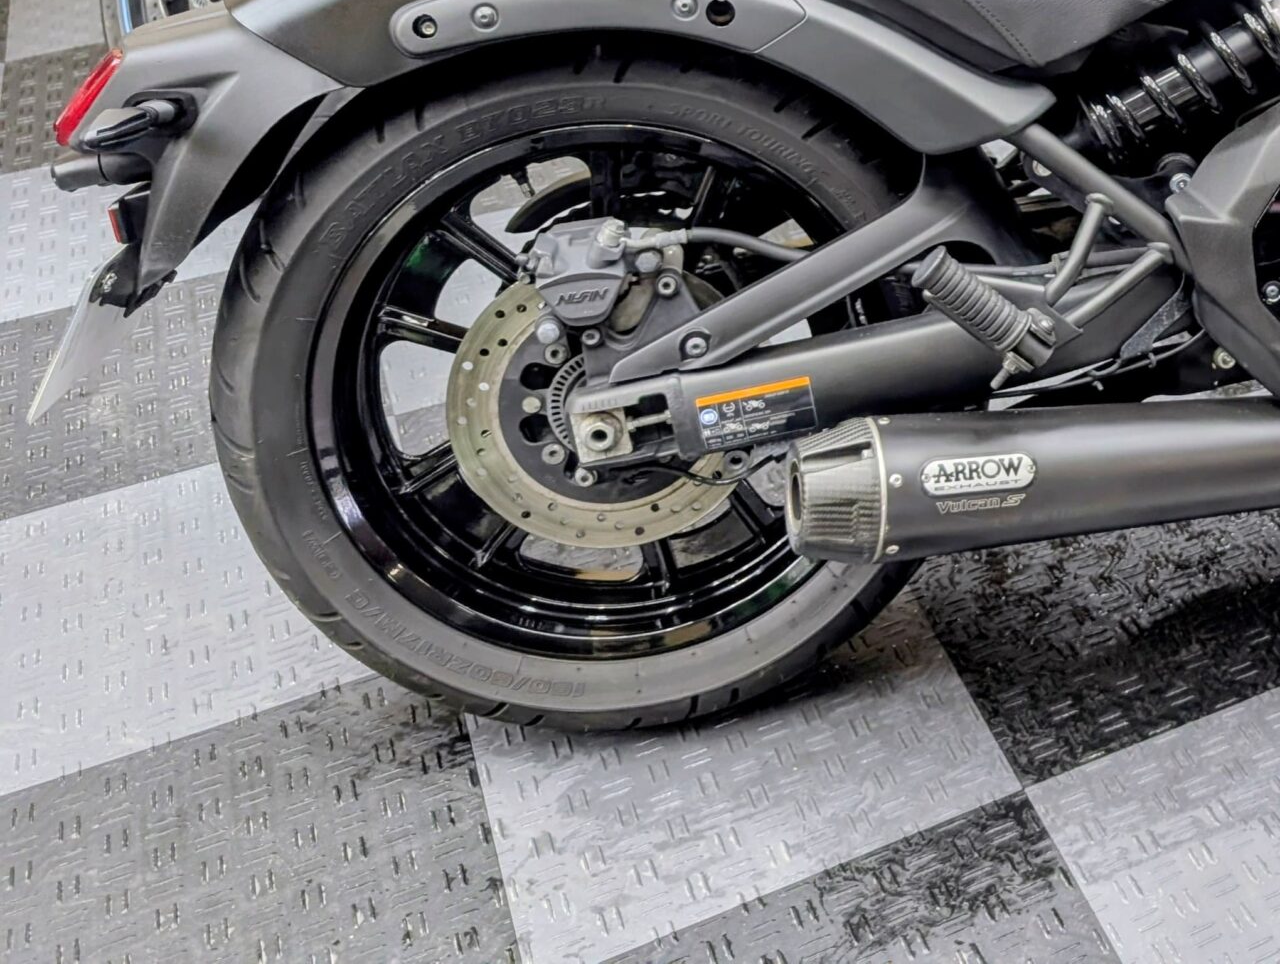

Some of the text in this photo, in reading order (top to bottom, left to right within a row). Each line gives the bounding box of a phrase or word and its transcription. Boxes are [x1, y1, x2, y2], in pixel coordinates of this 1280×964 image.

[932, 456, 1024, 484] ARROW
[934, 478, 1022, 492] EXHAUST
[936, 493, 1027, 515] Vulcan S
